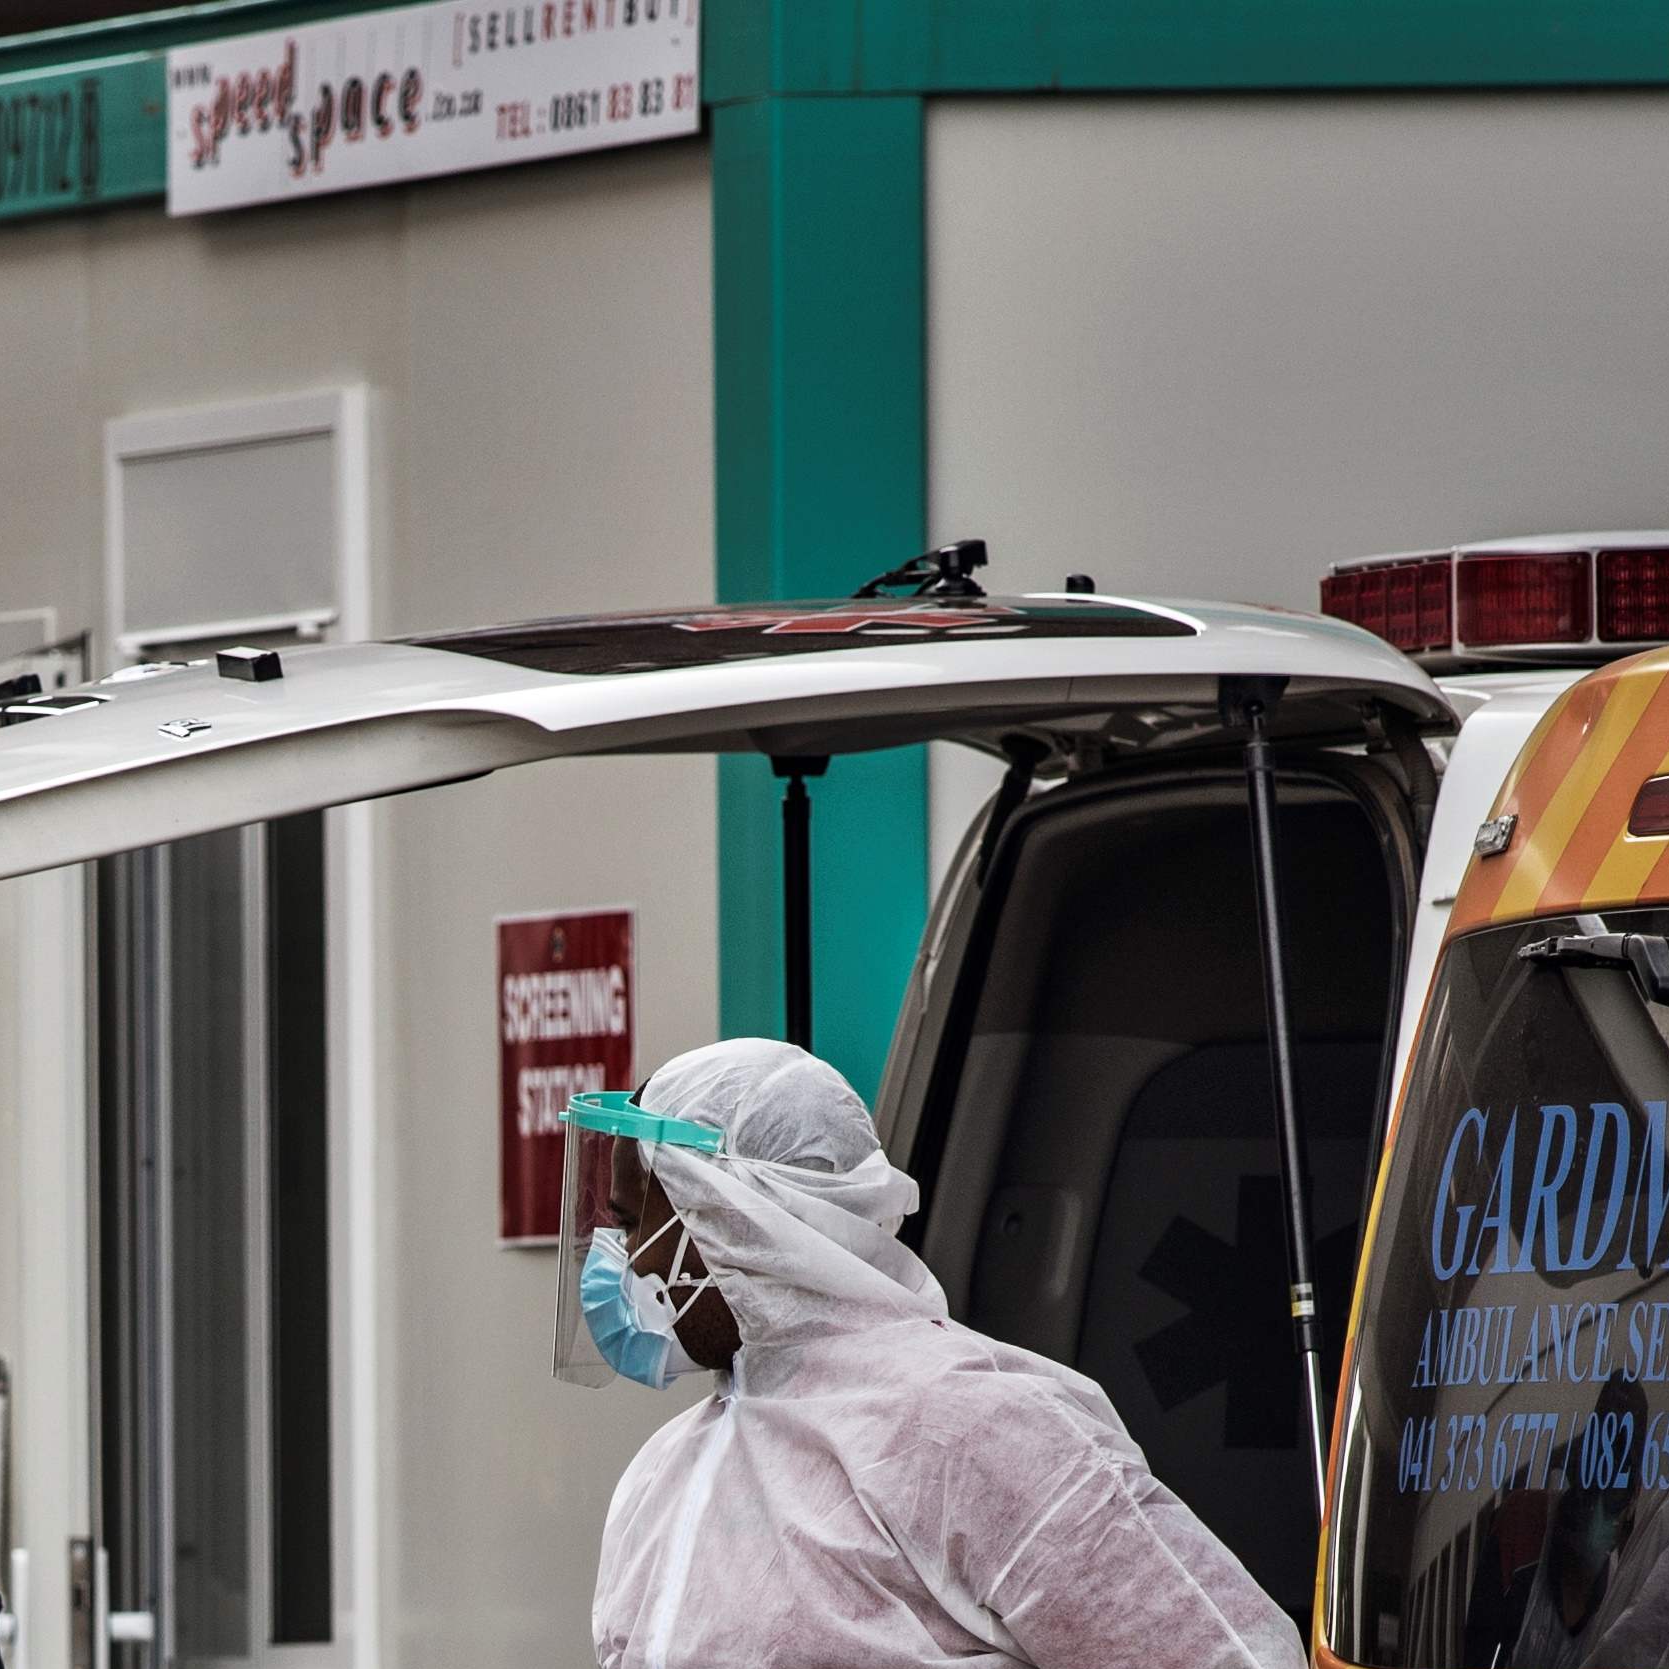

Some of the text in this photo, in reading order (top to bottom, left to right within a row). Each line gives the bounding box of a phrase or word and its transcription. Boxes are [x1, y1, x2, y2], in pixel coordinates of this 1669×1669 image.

[504, 964, 626, 1043] SCREENING
[1411, 1302, 1619, 1388] AMBULANCE
[1398, 1414, 1437, 1494] 041
[1439, 1413, 1487, 1492] 373
[1491, 1412, 1559, 1491] 6777
[1580, 1411, 1633, 1490] 082
